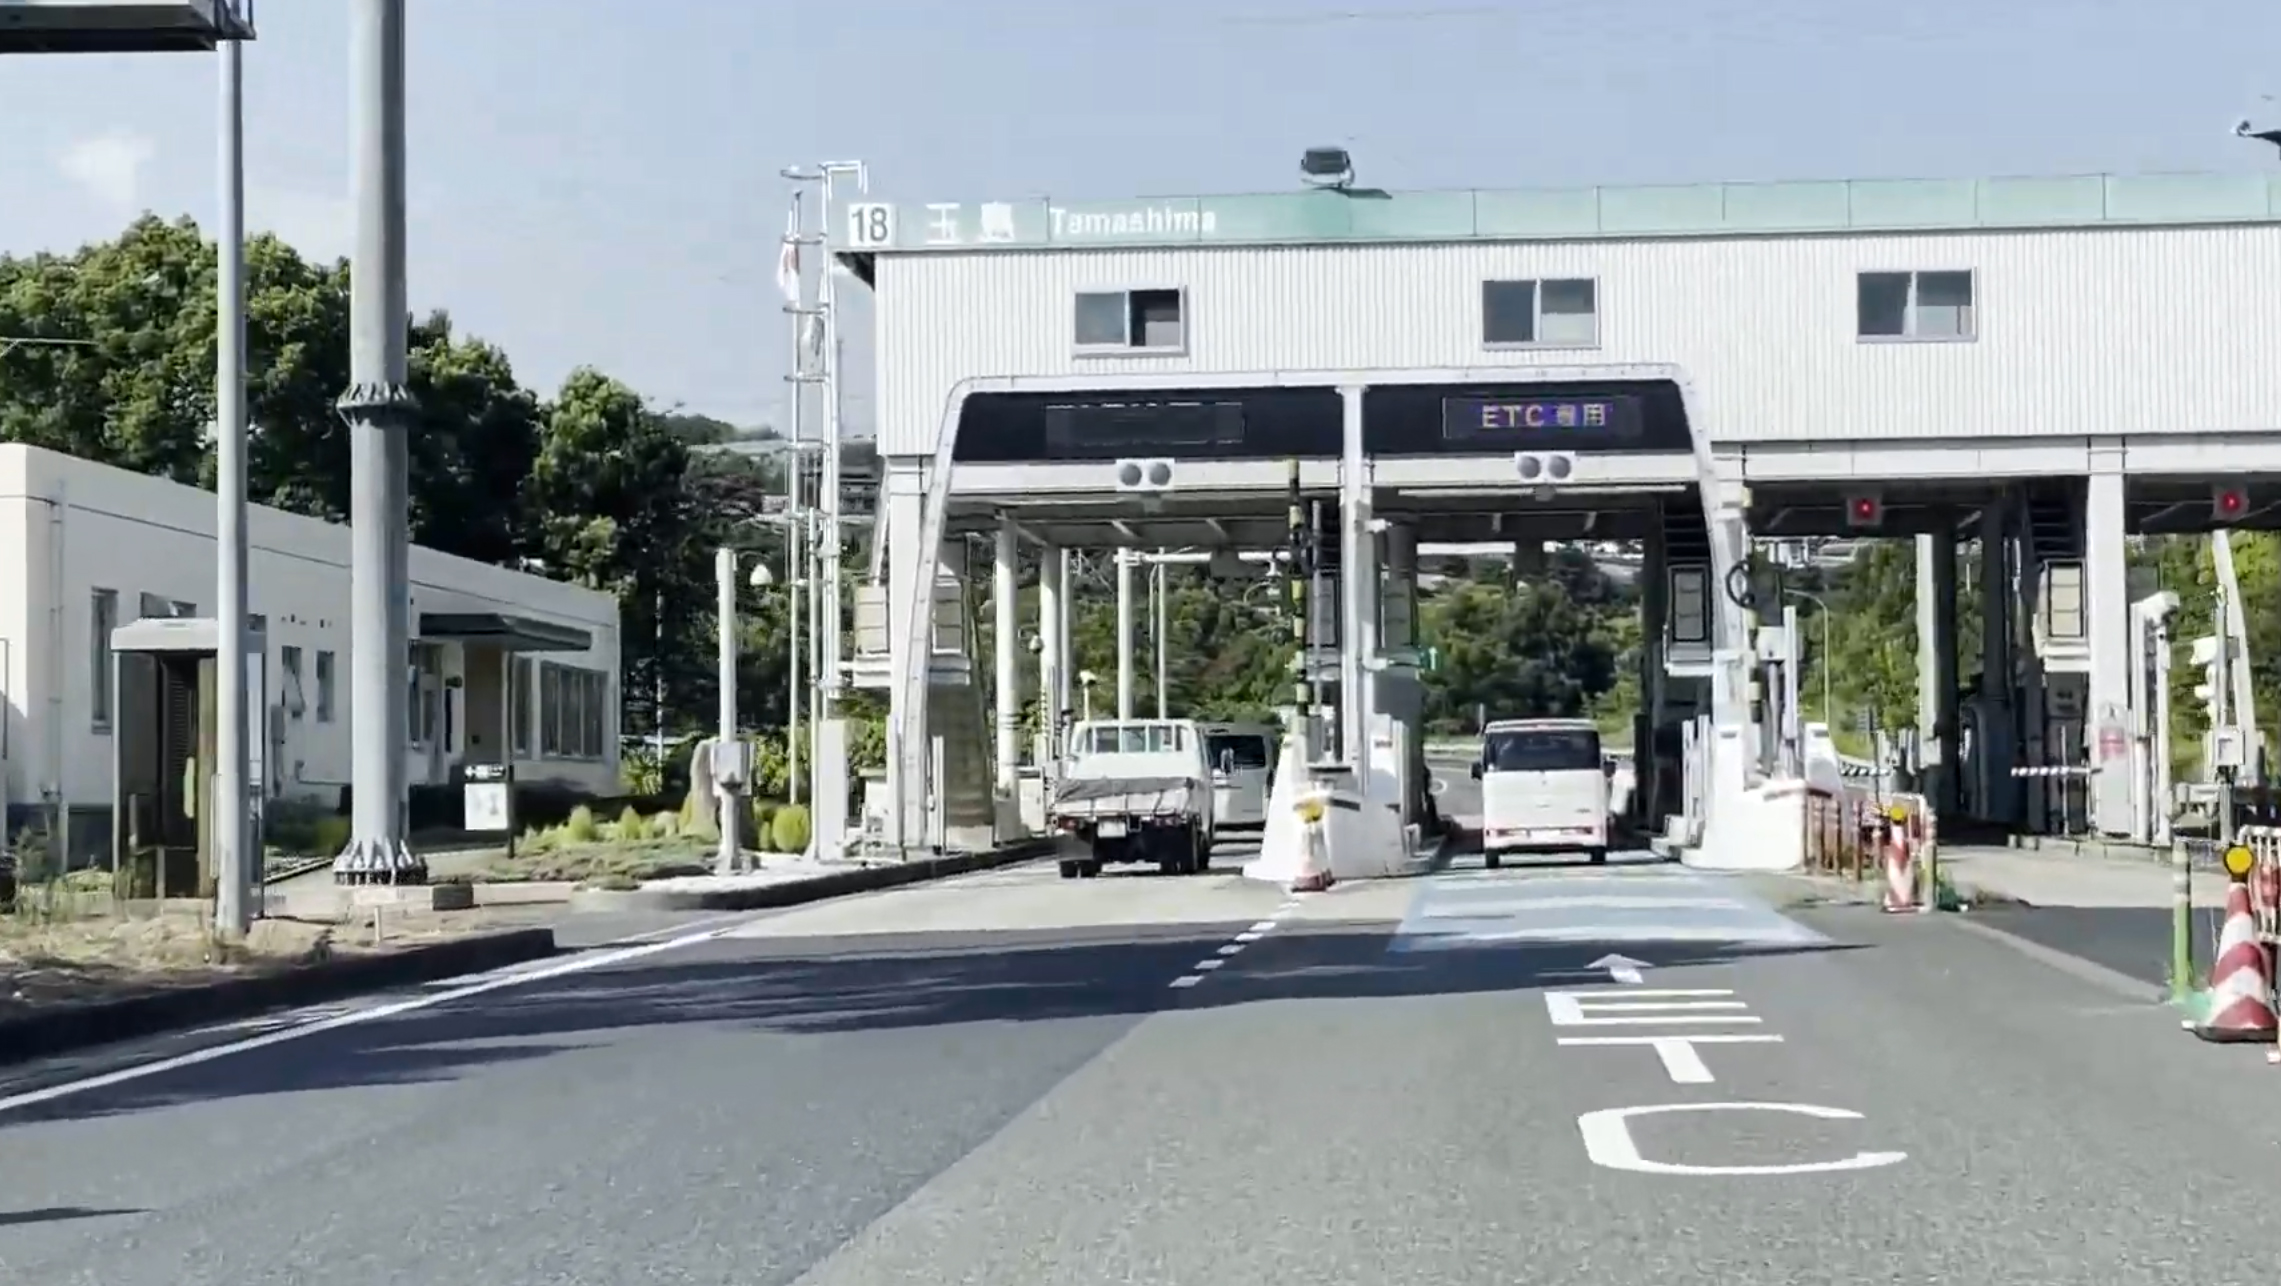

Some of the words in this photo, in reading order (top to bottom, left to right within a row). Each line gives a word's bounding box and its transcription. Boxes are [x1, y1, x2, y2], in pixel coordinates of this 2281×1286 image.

[851, 206, 888, 244] 18
[1049, 204, 1216, 236] Tamashima
[1481, 404, 1545, 428] ETC
